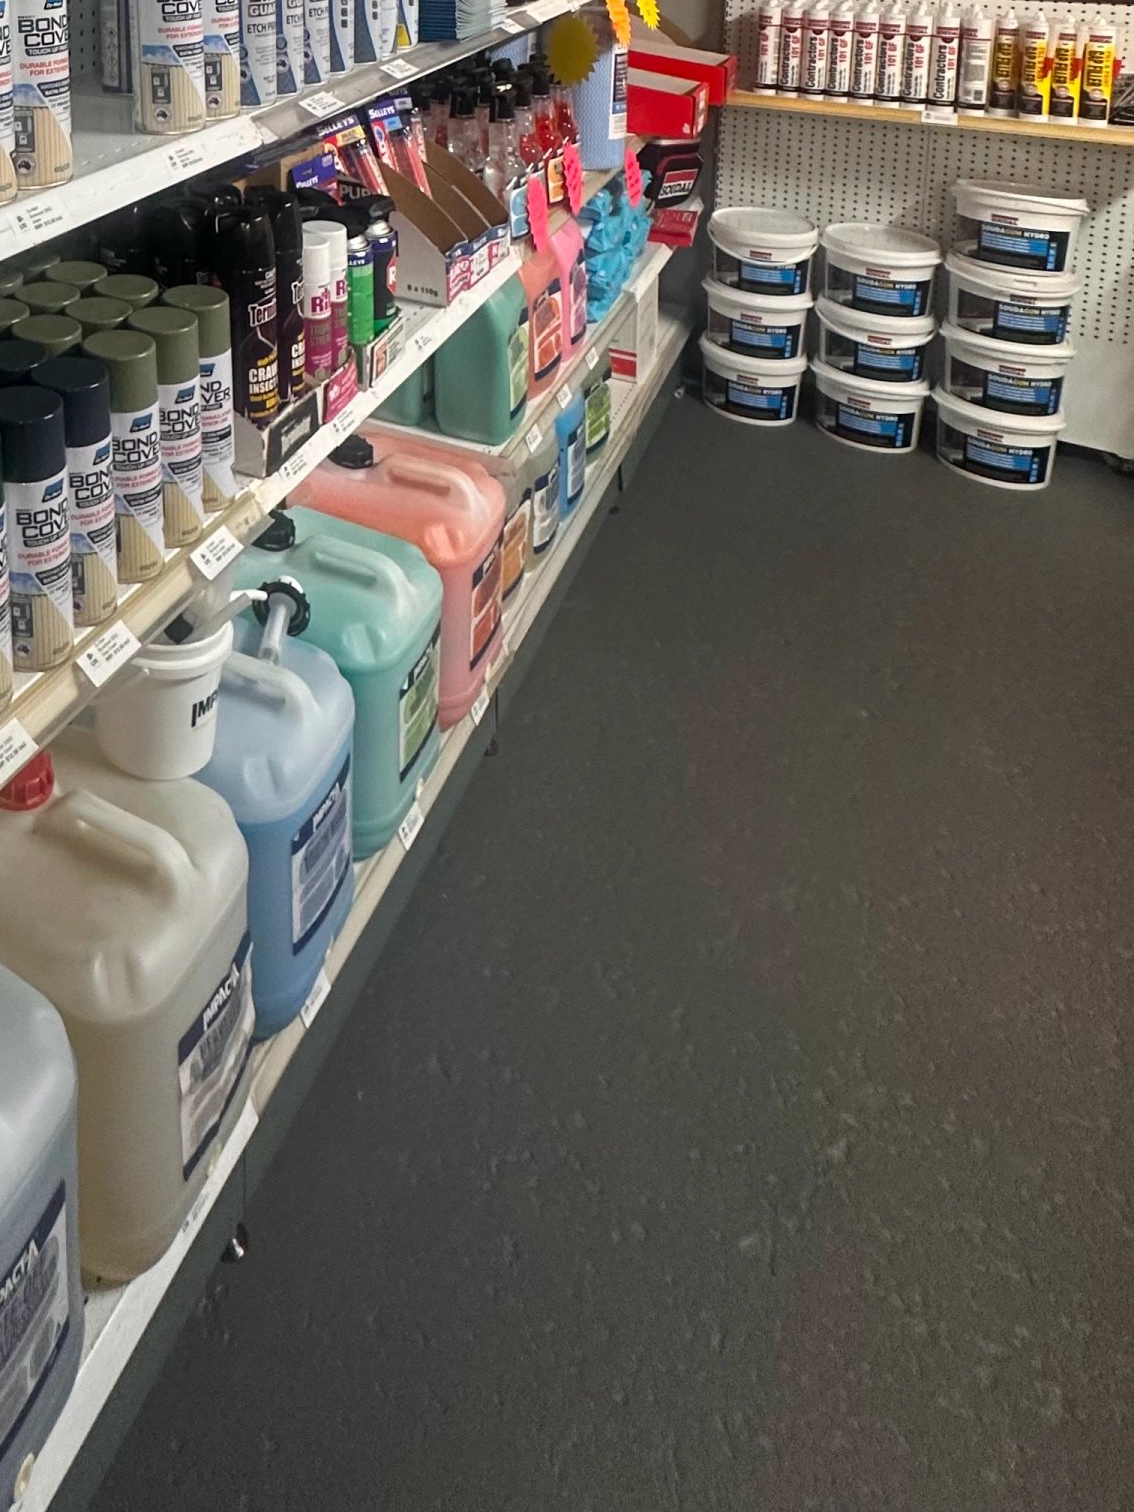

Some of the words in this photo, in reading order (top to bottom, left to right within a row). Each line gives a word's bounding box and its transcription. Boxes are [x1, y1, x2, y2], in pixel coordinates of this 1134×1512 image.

[247, 22, 266, 34] ETCH
[780, 34, 791, 85] Contractors
[805, 36, 818, 88] Contractors
[827, 38, 838, 90] Contractors
[853, 40, 864, 92] Contractors
[877, 41, 887, 94] Contractors
[903, 43, 914, 96] Contractors
[914, 56, 924, 69] 101
[933, 45, 947, 99] Contractors
[947, 58, 955, 71] 101
[1023, 230, 1049, 240] HYDRO
